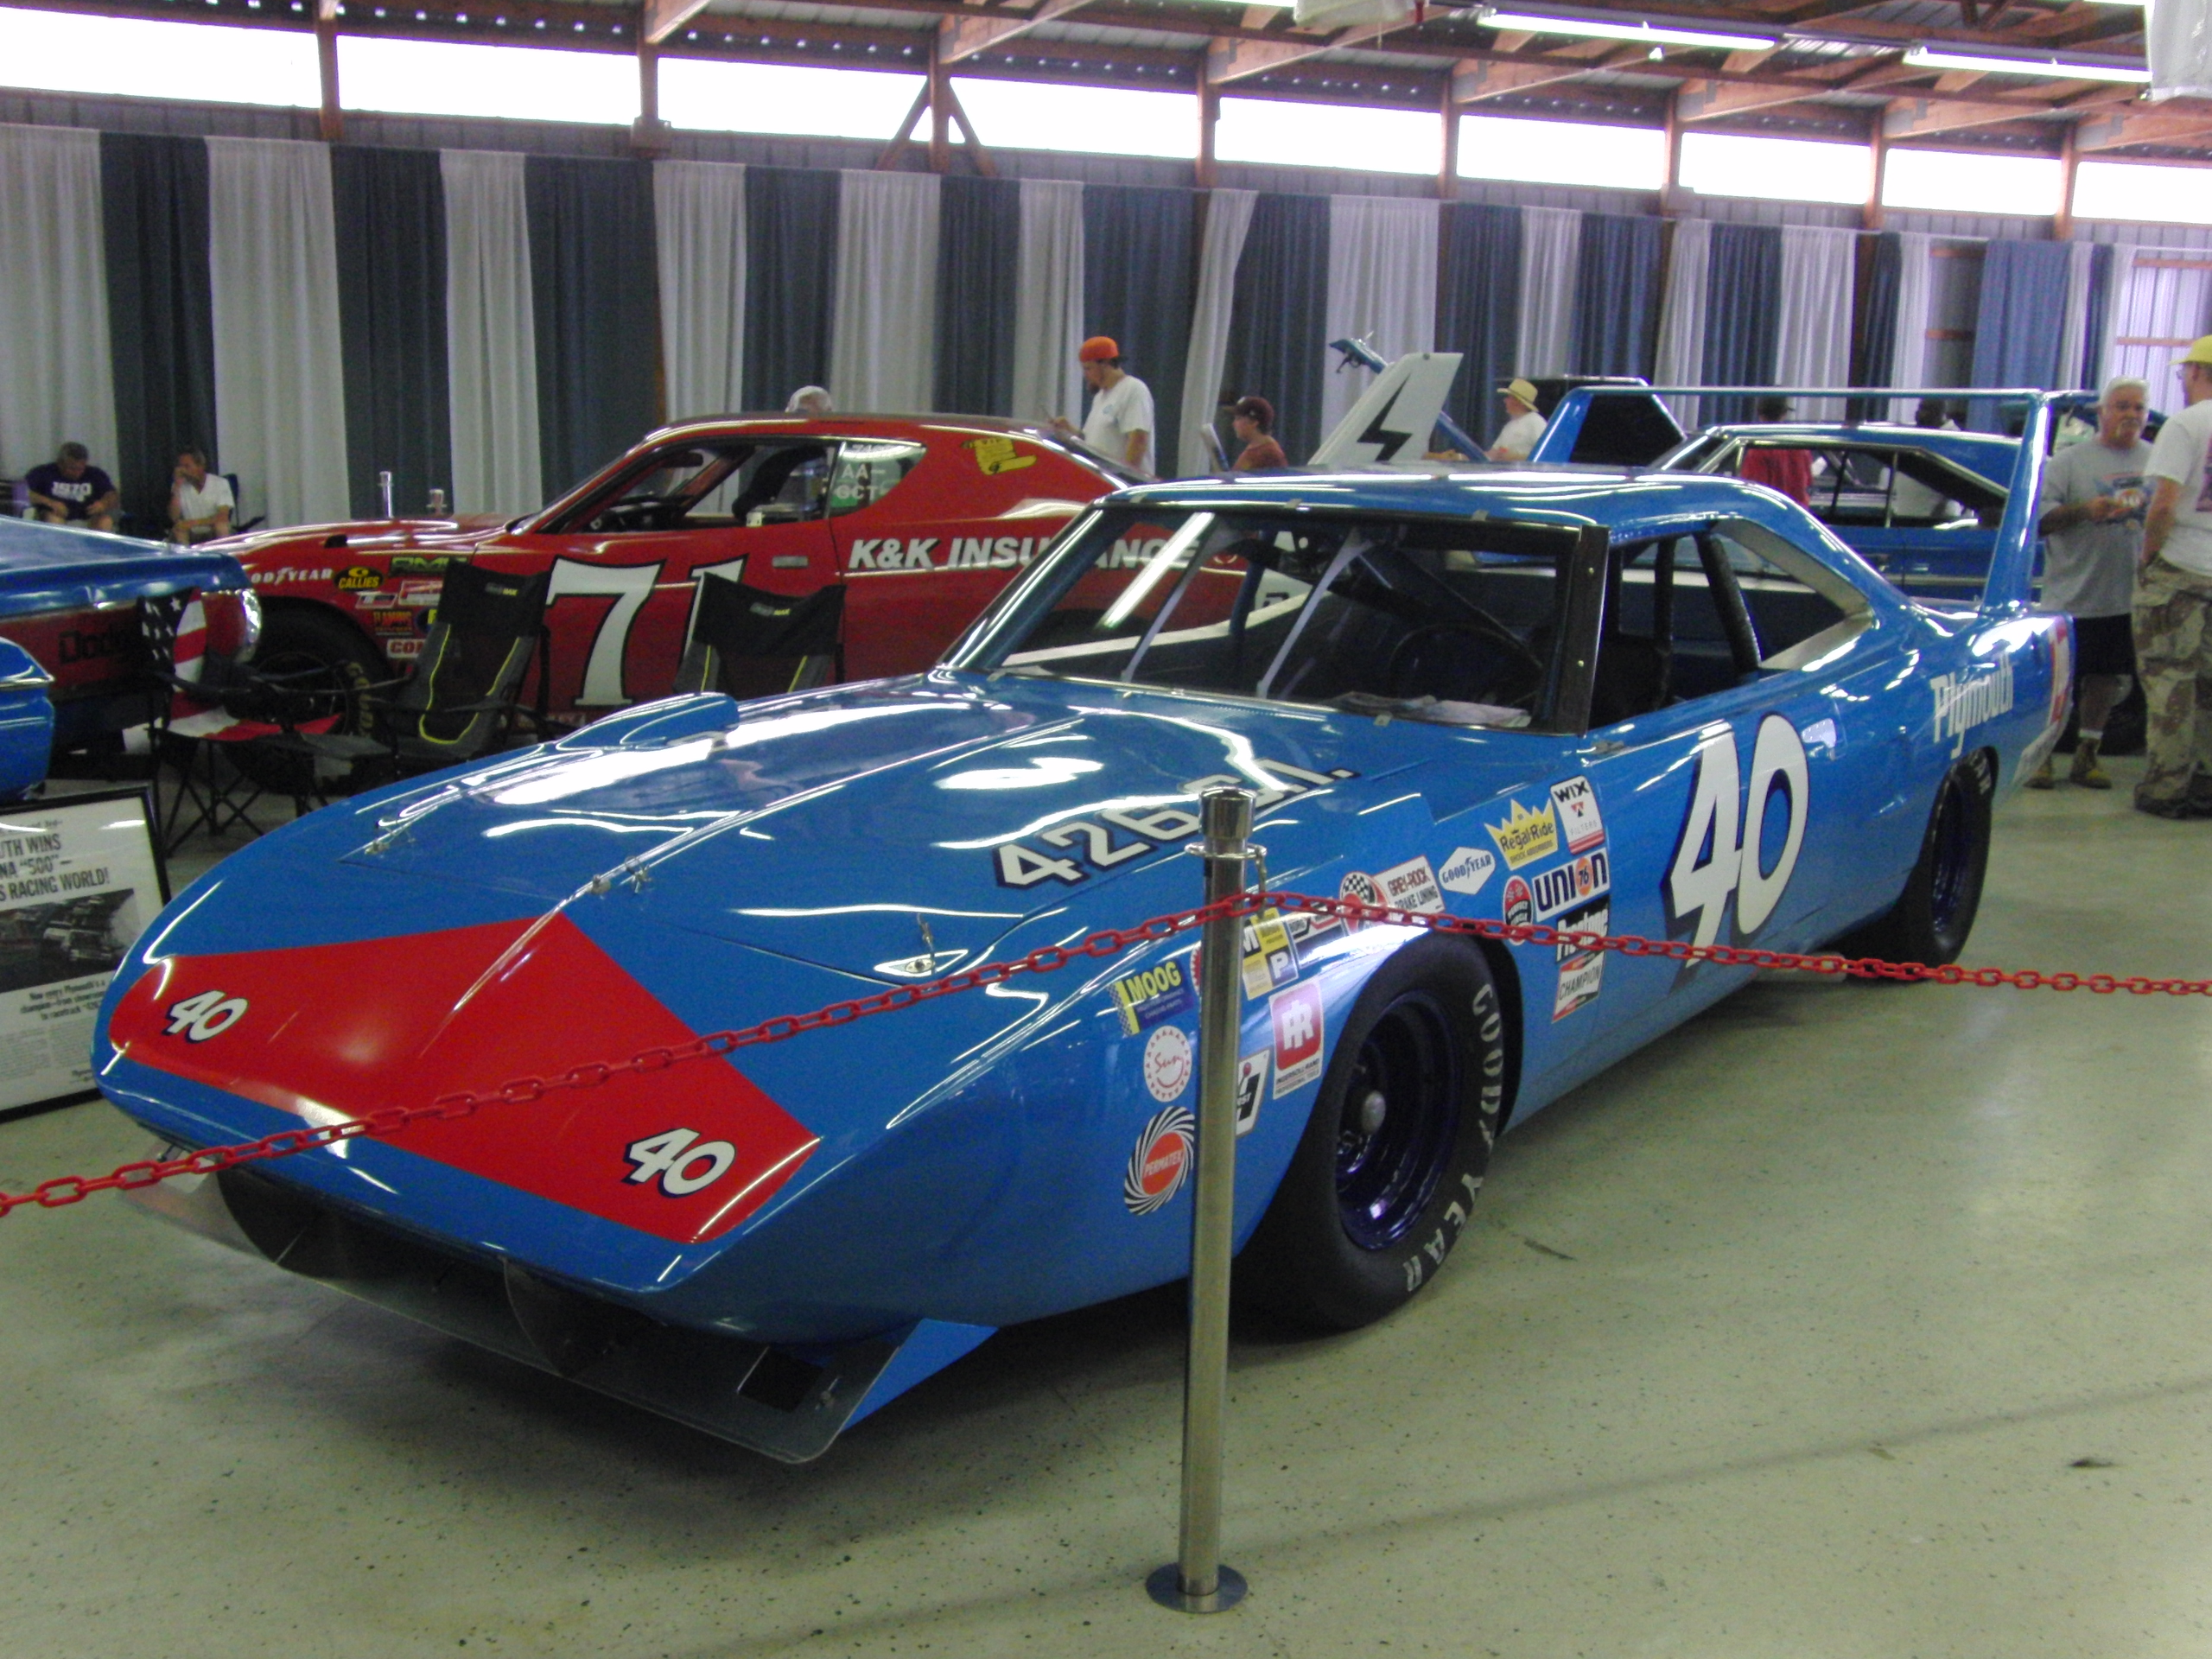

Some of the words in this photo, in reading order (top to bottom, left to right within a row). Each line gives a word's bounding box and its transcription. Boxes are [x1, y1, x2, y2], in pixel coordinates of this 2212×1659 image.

[848, 537, 942, 570] K&K
[251, 567, 334, 586] ODYEAR
[338, 576, 379, 589] CALLIES
[1554, 781, 1590, 803] WIX
[25, 833, 61, 854] WINS
[993, 804, 1205, 890] 426
[1660, 710, 1810, 985] 40
[8, 874, 59, 899] RACING
[59, 867, 110, 891] WORLD!
[1442, 855, 1492, 883] GOODYEAR
[1126, 961, 1182, 1003] MOOG
[1559, 965, 1601, 1001] CHAMPION
[162, 988, 250, 1042] 40
[1403, 982, 1503, 1293] GOODYEAR
[621, 1127, 737, 1198] 40
